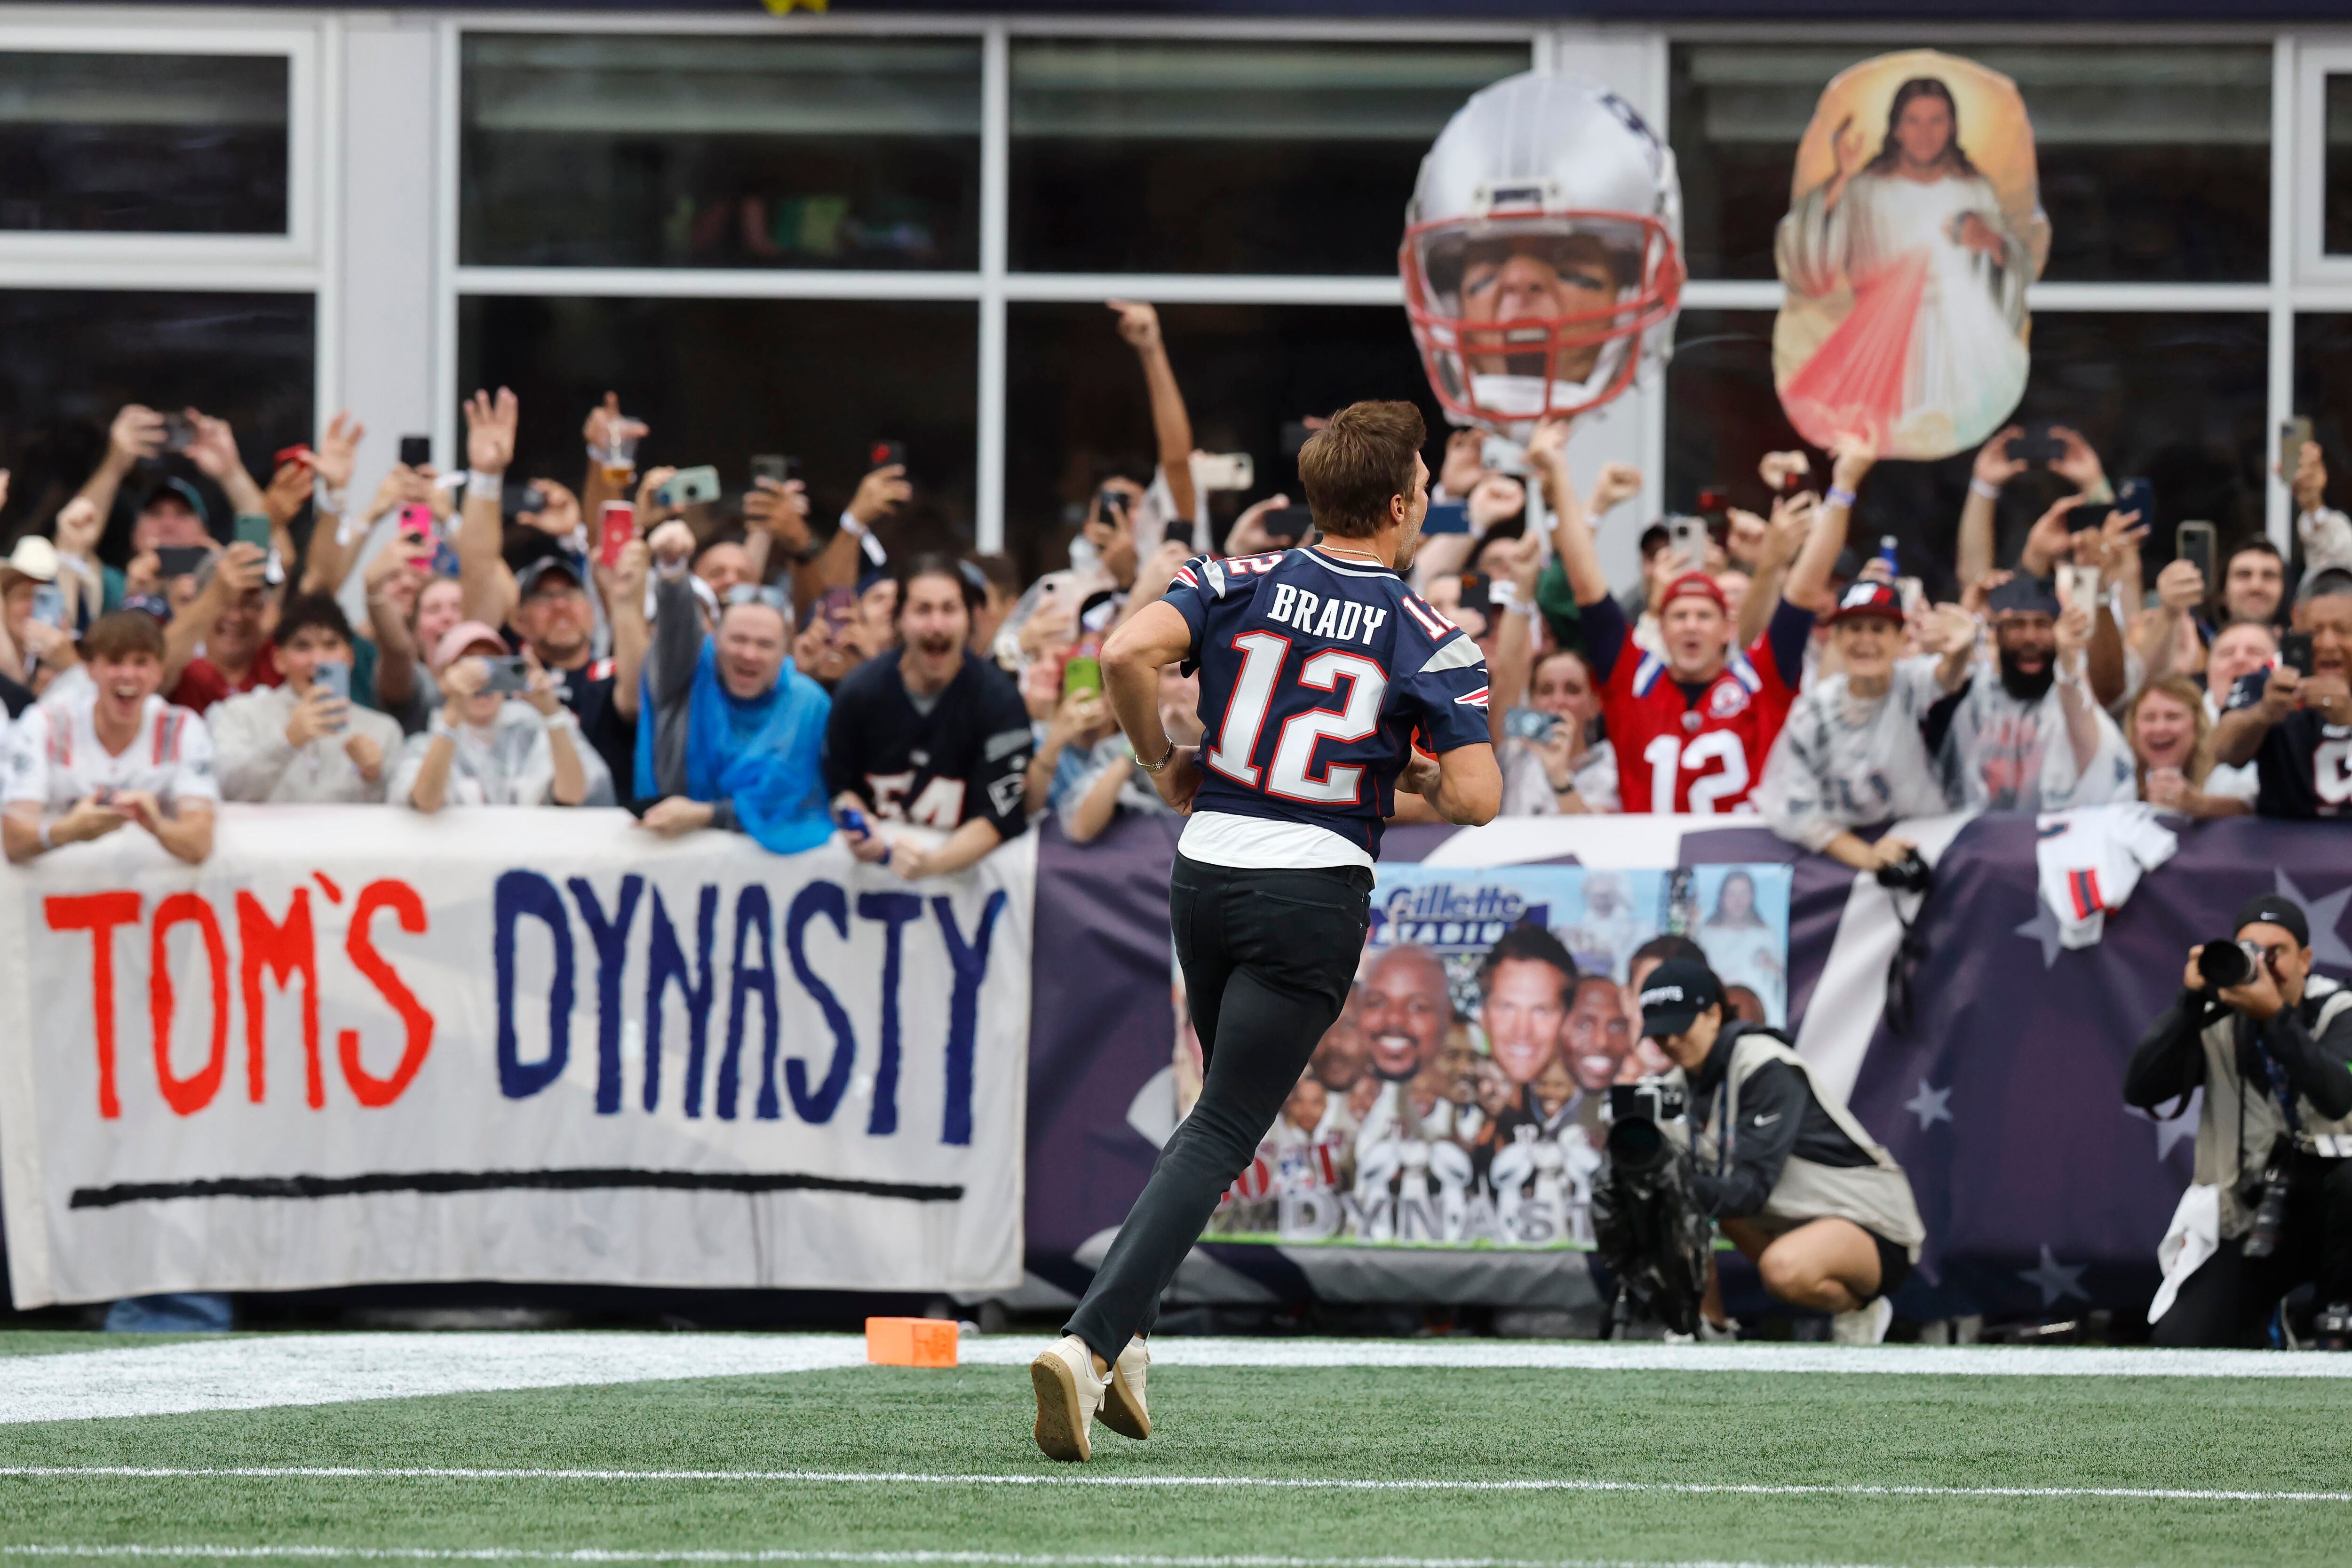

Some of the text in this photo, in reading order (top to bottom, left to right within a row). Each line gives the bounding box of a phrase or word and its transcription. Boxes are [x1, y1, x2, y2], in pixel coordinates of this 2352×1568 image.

[1267, 583, 1387, 645] BRADY
[1207, 630, 1389, 805] 12
[864, 768, 967, 829] 54
[1644, 729, 1756, 814] 12
[1387, 882, 1526, 920] Gillette
[1375, 922, 1506, 944] STADIU
[44, 868, 1008, 1146] TOM'S DYNASTY
[1278, 1189, 1598, 1248] DYNAST
